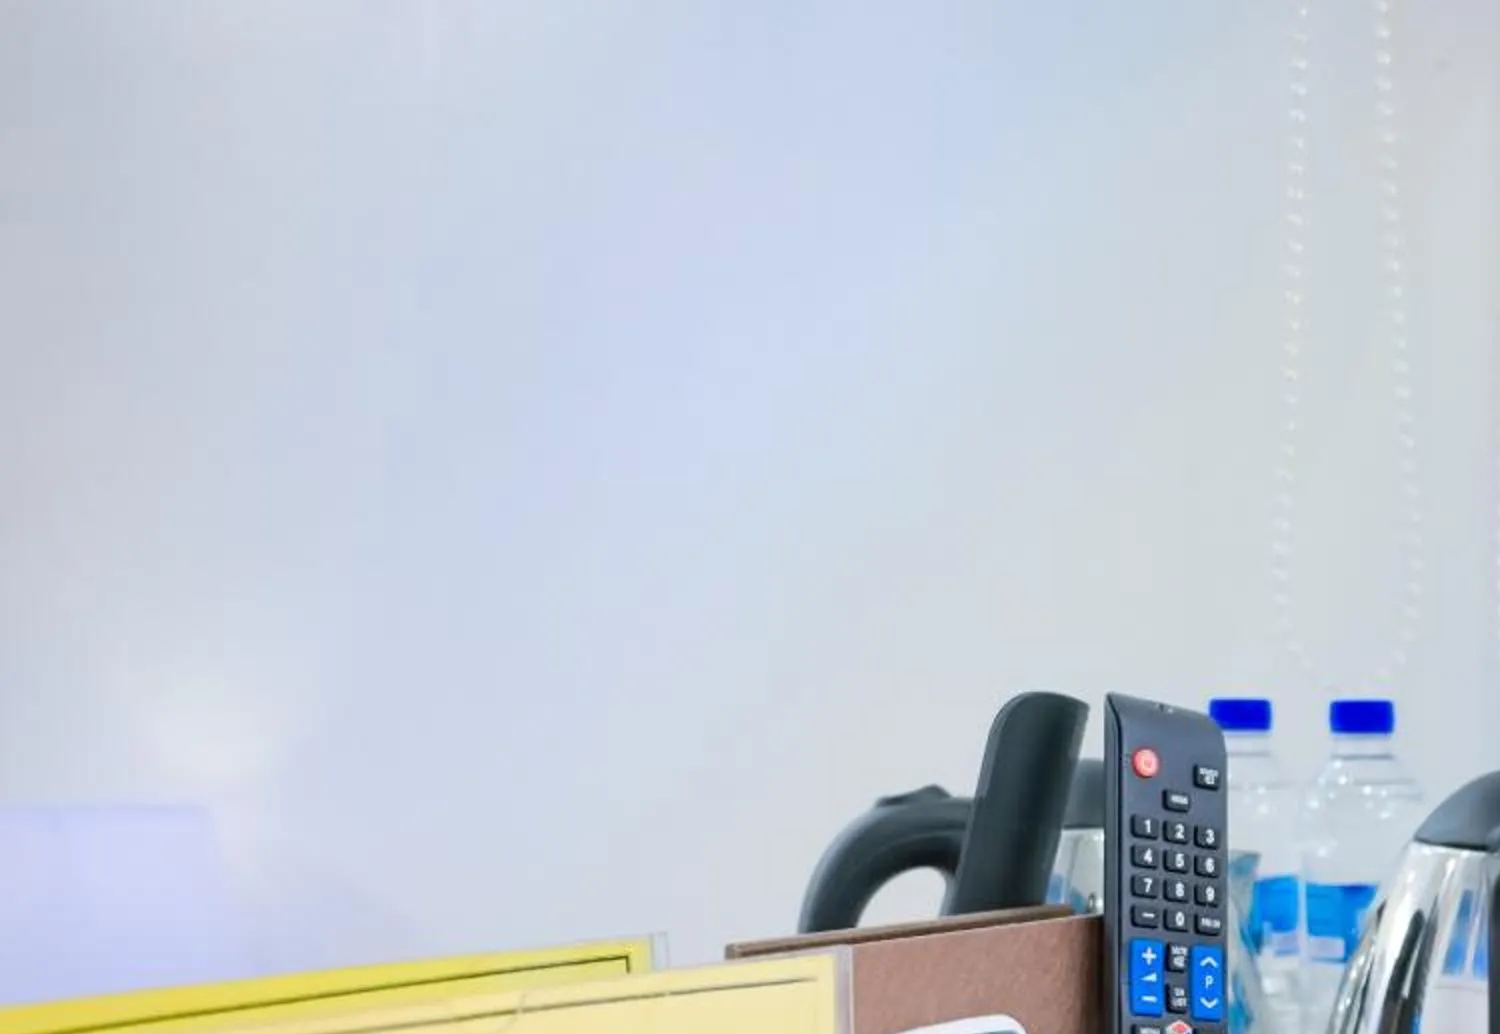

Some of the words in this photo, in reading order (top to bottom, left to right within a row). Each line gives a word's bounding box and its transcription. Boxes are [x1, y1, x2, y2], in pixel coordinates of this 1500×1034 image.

[1144, 819, 1152, 833] 1
[1174, 823, 1185, 839] 2
[1205, 829, 1215, 844] 3
[1144, 848, 1153, 864] 4
[1175, 853, 1184, 868] 5
[1205, 857, 1215, 873] 6
[1144, 878, 1153, 893] 7
[1175, 882, 1184, 897] 8
[1205, 886, 1215, 902] 9
[1205, 975, 1214, 989] P
